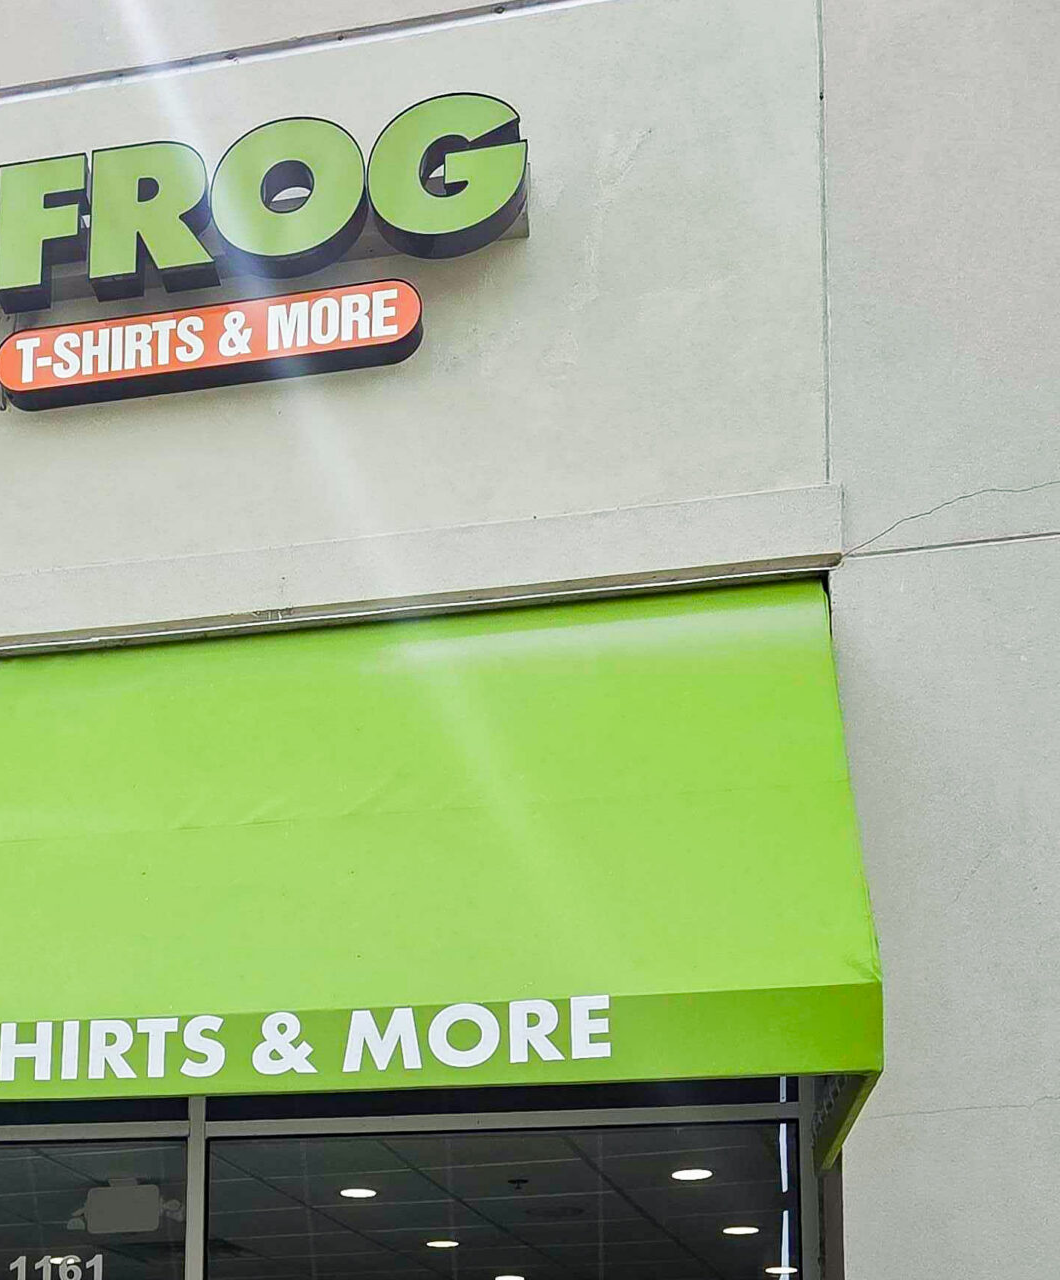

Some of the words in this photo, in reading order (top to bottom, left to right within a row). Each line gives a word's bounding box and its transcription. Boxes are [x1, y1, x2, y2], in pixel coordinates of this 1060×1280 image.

[15, 315, 205, 384] T-SHIRTS
[218, 310, 253, 357] &
[267, 288, 399, 349] MORE
[251, 1011, 319, 1076] &
[342, 994, 613, 1074] MORE
